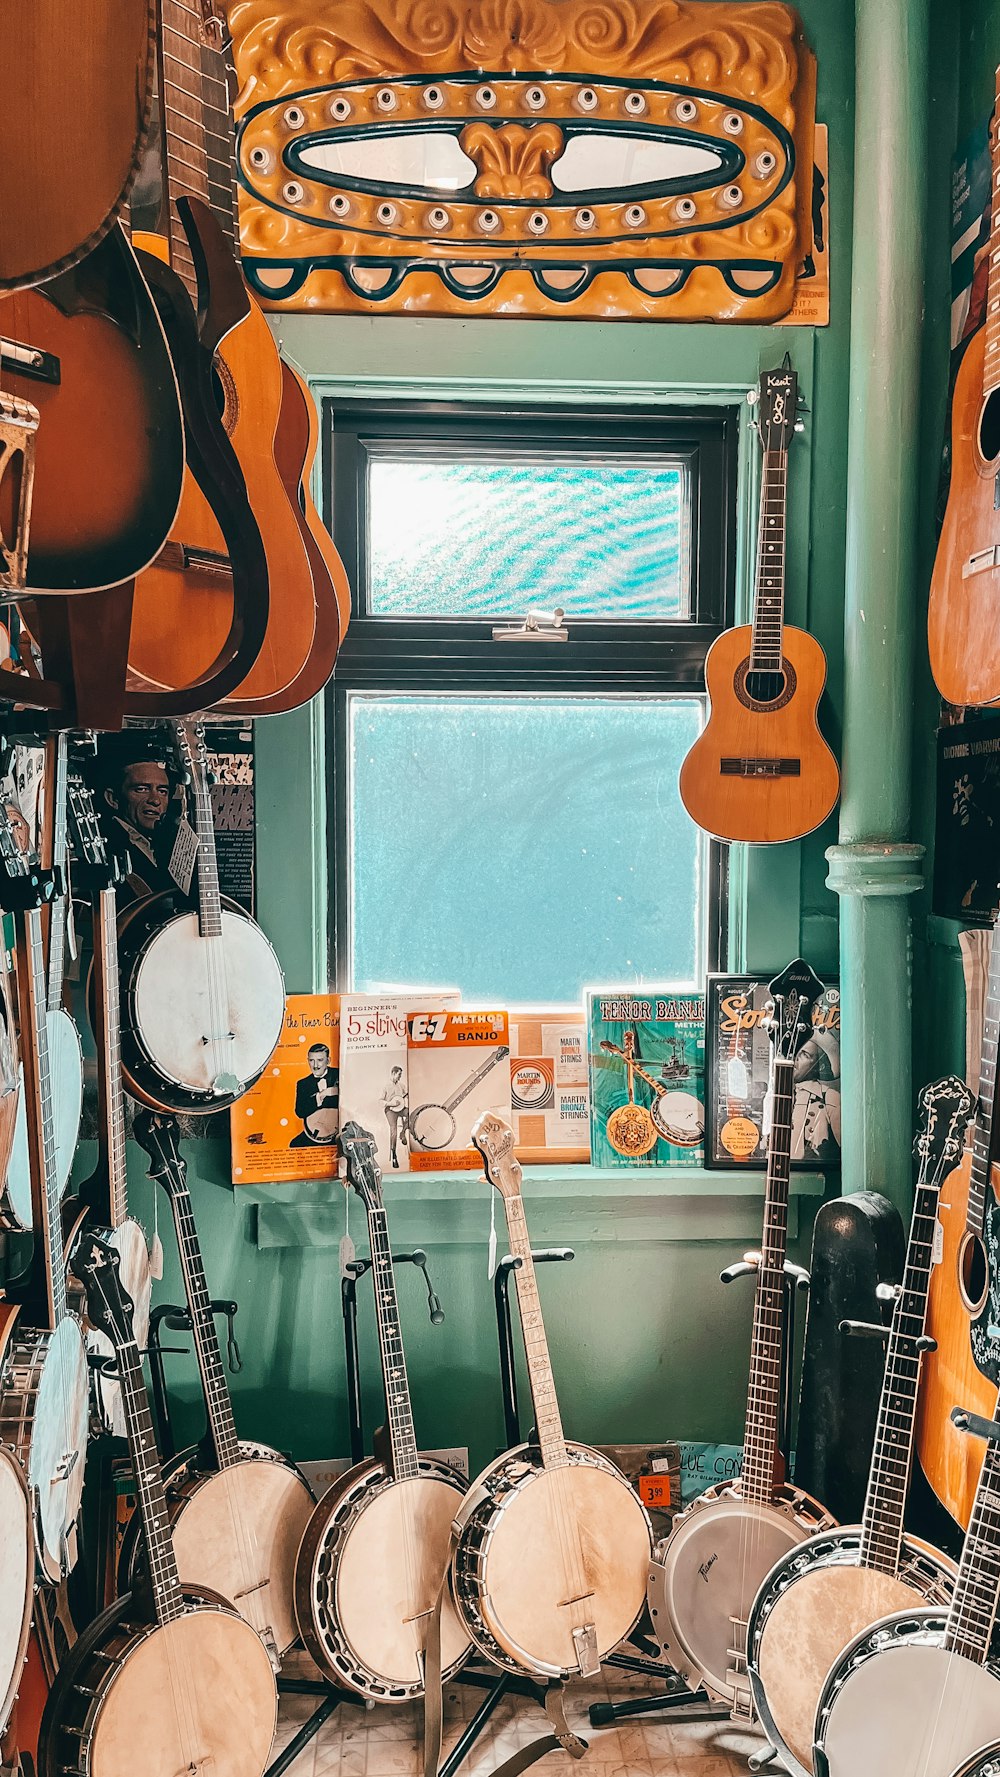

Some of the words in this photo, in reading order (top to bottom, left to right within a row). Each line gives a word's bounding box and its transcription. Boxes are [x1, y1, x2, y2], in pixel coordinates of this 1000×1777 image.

[767, 374, 793, 387] Kent
[347, 1004, 398, 1012] BEGINNER'S
[600, 1000, 652, 1022] TENOR
[285, 1014, 298, 1028] the
[299, 1013, 321, 1028] Tenor
[347, 1014, 371, 1036] 5
[457, 1031, 498, 1041] BANJO
[560, 1038, 581, 1046] MARTIN
[560, 1054, 582, 1064] STRINGS
[560, 1095, 587, 1104] MARTIN
[560, 1103, 586, 1111] BRONZE
[560, 1111, 588, 1120] STRINGS
[679, 1454, 706, 1473] LUE
